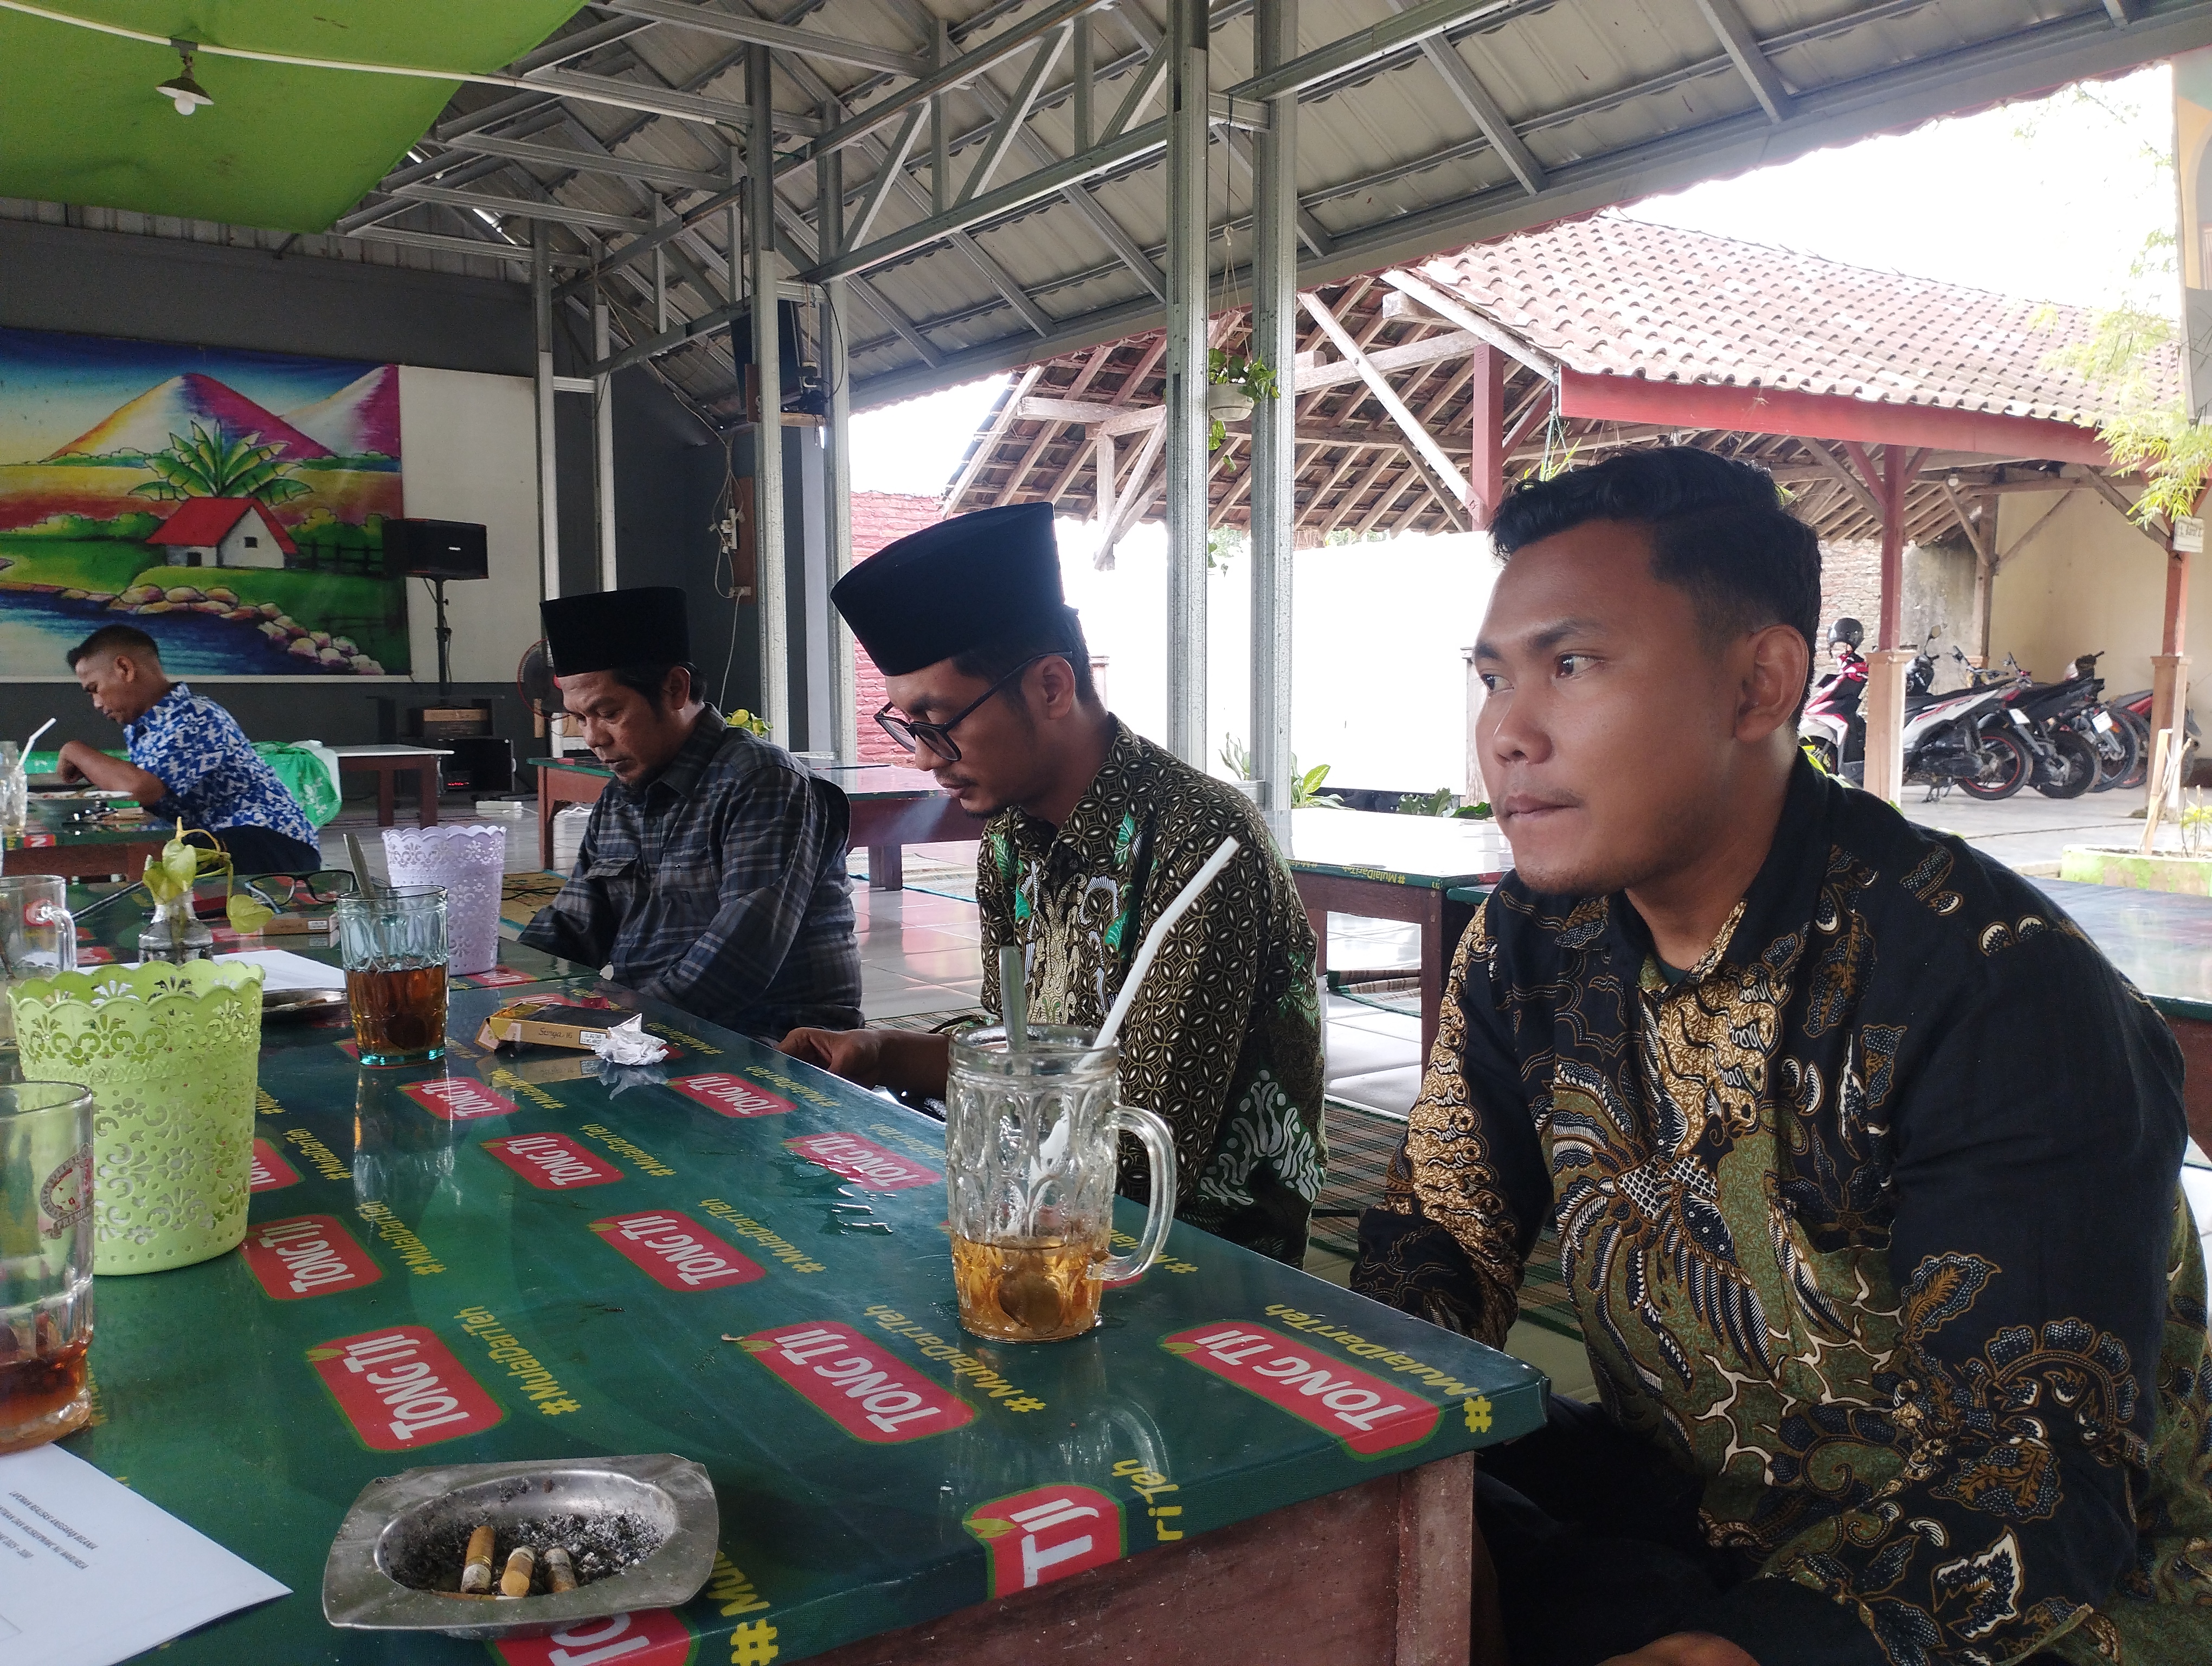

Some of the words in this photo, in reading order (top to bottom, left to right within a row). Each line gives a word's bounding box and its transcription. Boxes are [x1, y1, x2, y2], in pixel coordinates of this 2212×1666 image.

[422, 1080, 467, 1094] TJI
[685, 1076, 730, 1091] TJI
[708, 1086, 780, 1114] TONG
[743, 1066, 840, 1107] #MulaiDariTeh
[437, 1090, 500, 1117] TONG
[506, 1136, 557, 1154] TJI
[579, 1124, 676, 1176] #MulaiDariTeh
[805, 1137, 858, 1155] TJI
[869, 1124, 946, 1160] laiDariTeh
[526, 1150, 602, 1186] TONG
[833, 1150, 920, 1187] TONG
[259, 1221, 323, 1249] TJI
[355, 1201, 447, 1275] #MulaiDariTeh
[617, 1215, 677, 1240] TJI
[698, 1199, 827, 1273] #MulaiDariTeh
[276, 1240, 356, 1293] TONG
[644, 1234, 739, 1285] TONG
[343, 1334, 421, 1373] TJI
[453, 1306, 581, 1415] #MulaiDariTeh
[774, 1329, 849, 1366] TJI
[865, 1305, 1046, 1413] #MulaiDariTeh
[1195, 1330, 1274, 1366] TJI
[1265, 1304, 1493, 1433] #MulaiDariTeh
[366, 1362, 470, 1440] TONG
[813, 1356, 941, 1433] TONG
[1252, 1356, 1406, 1432] TONG
[1009, 1498, 1099, 1588] TJI
